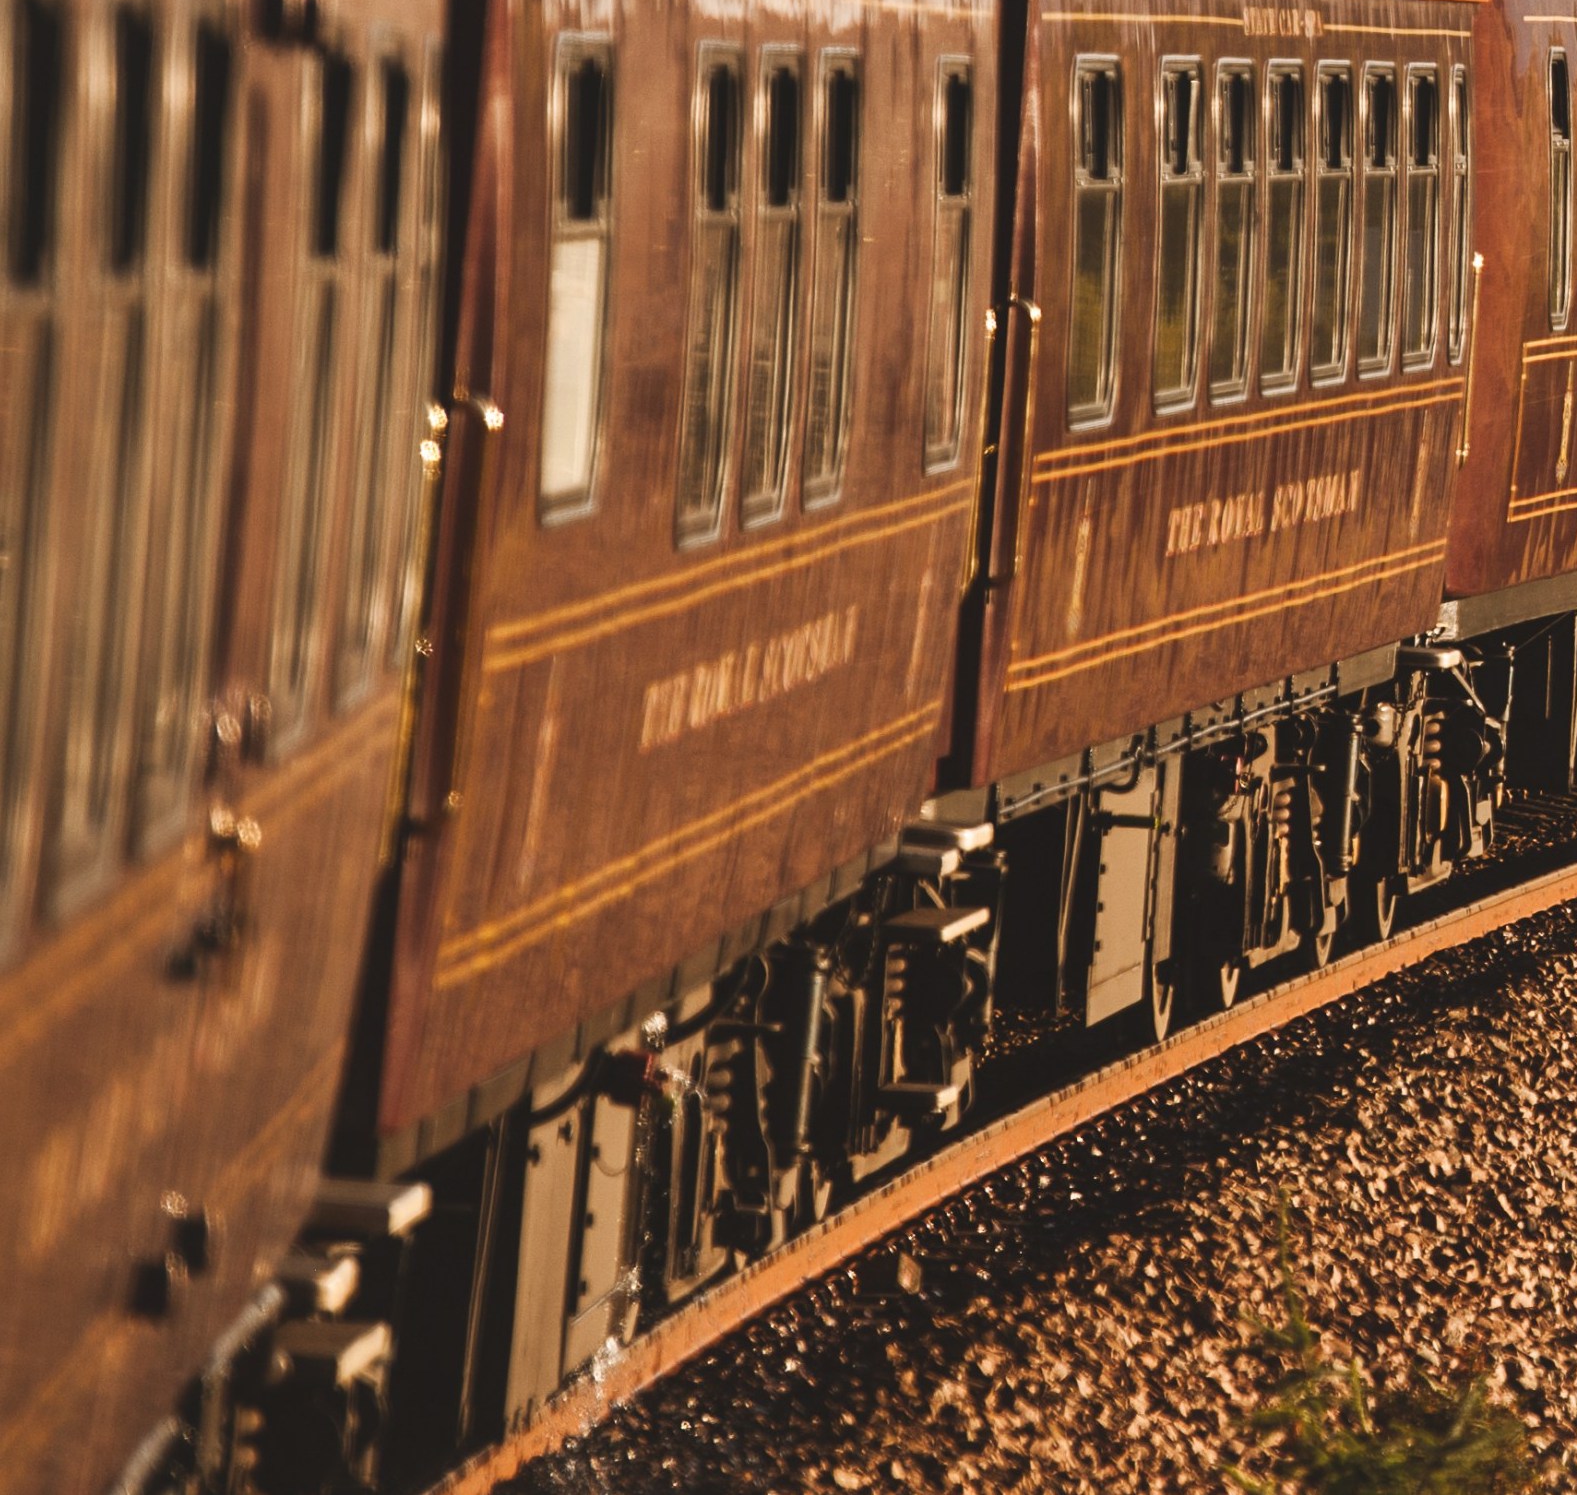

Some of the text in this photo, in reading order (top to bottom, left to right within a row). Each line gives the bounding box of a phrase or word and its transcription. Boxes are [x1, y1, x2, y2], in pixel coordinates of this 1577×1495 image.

[1166, 469, 1360, 557] THE ROYAL SCOTSMAN
